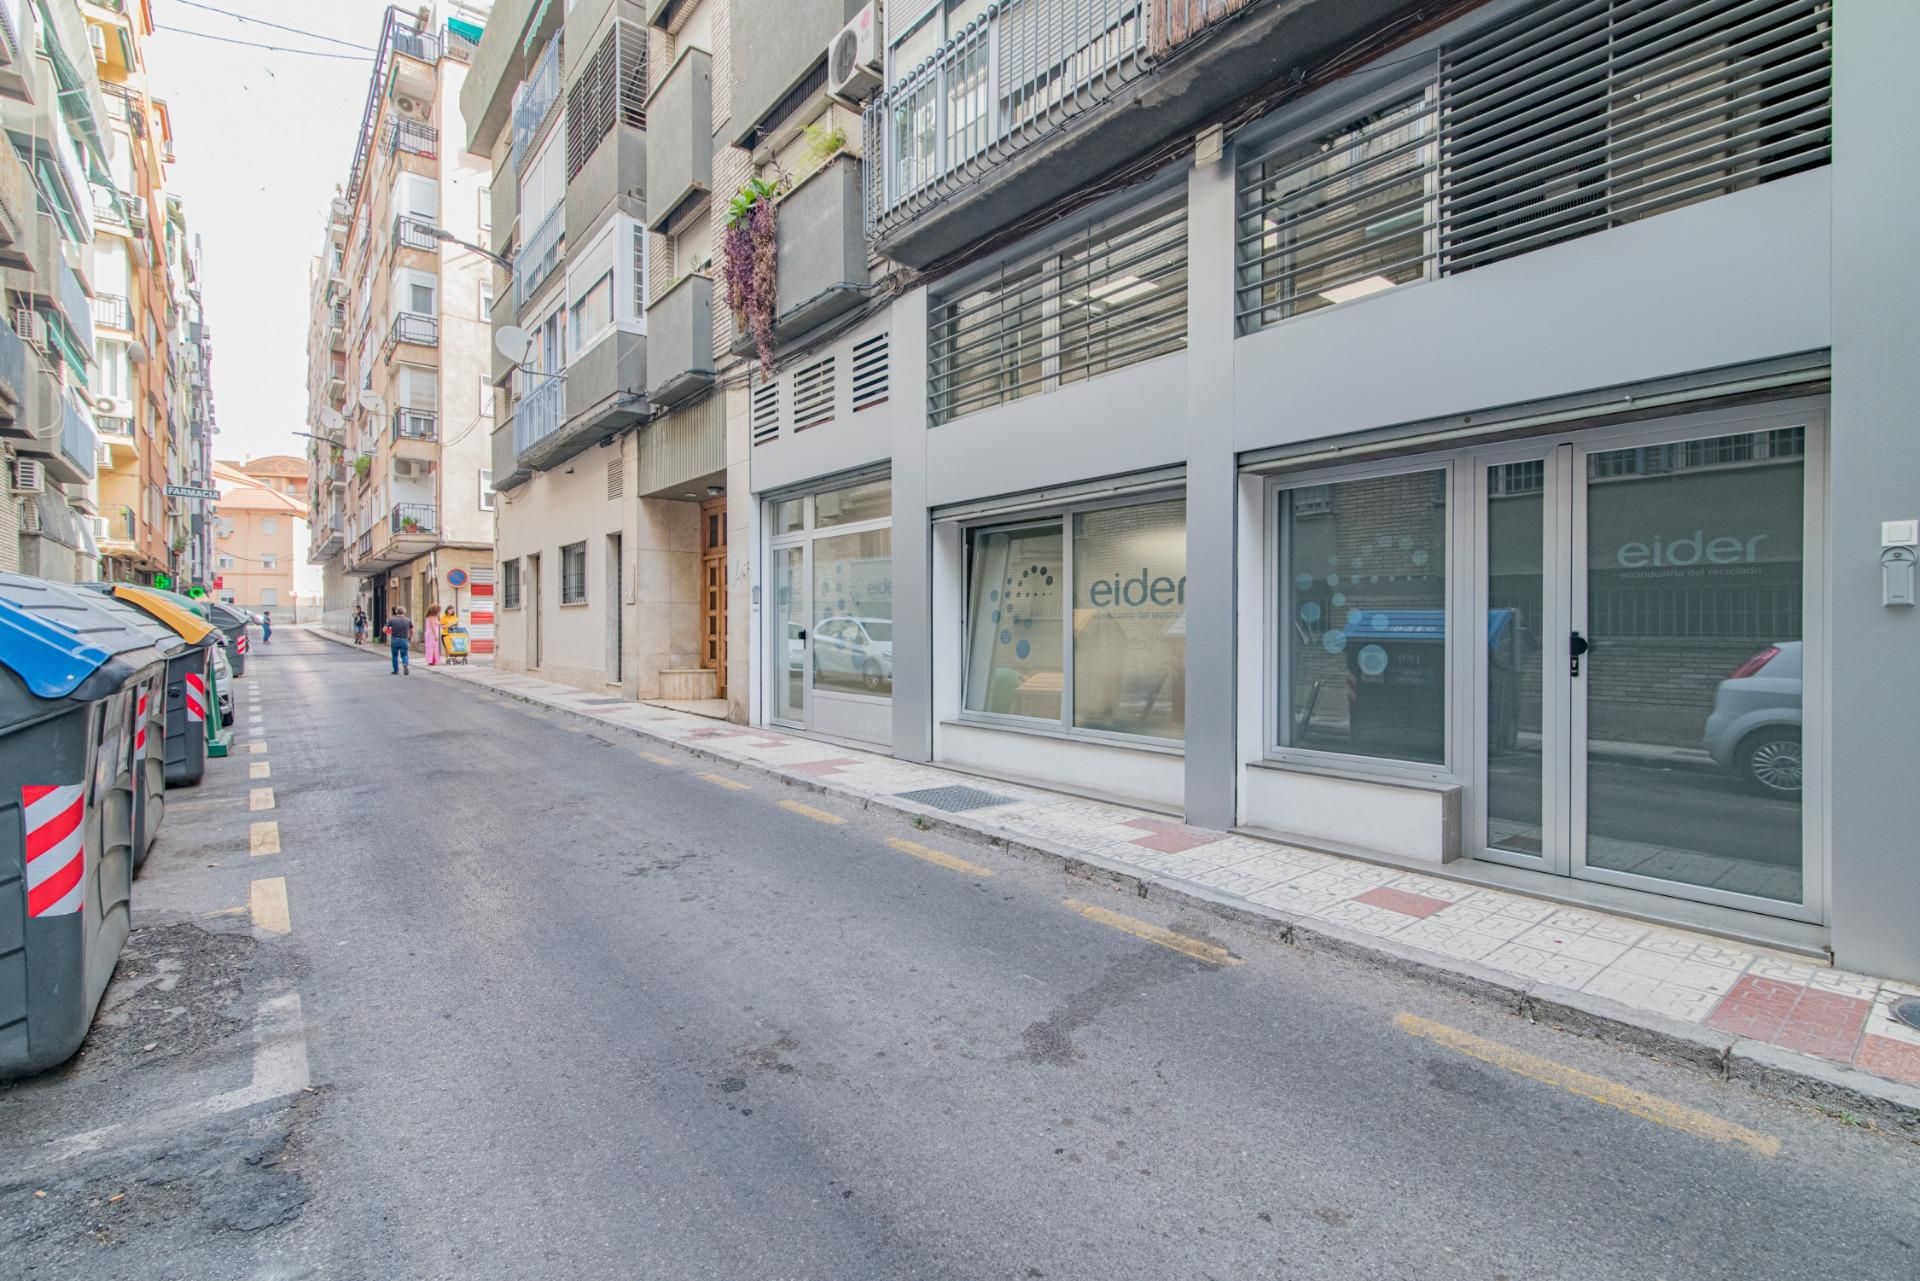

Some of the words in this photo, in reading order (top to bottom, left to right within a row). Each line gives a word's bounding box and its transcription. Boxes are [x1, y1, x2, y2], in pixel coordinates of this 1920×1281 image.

[167, 487, 219, 499] FARMACIA
[1617, 529, 1768, 568] eider
[1687, 567, 1705, 576] del
[1708, 566, 1762, 576] reciclado
[867, 575, 892, 596] eide
[1090, 567, 1187, 608] eider
